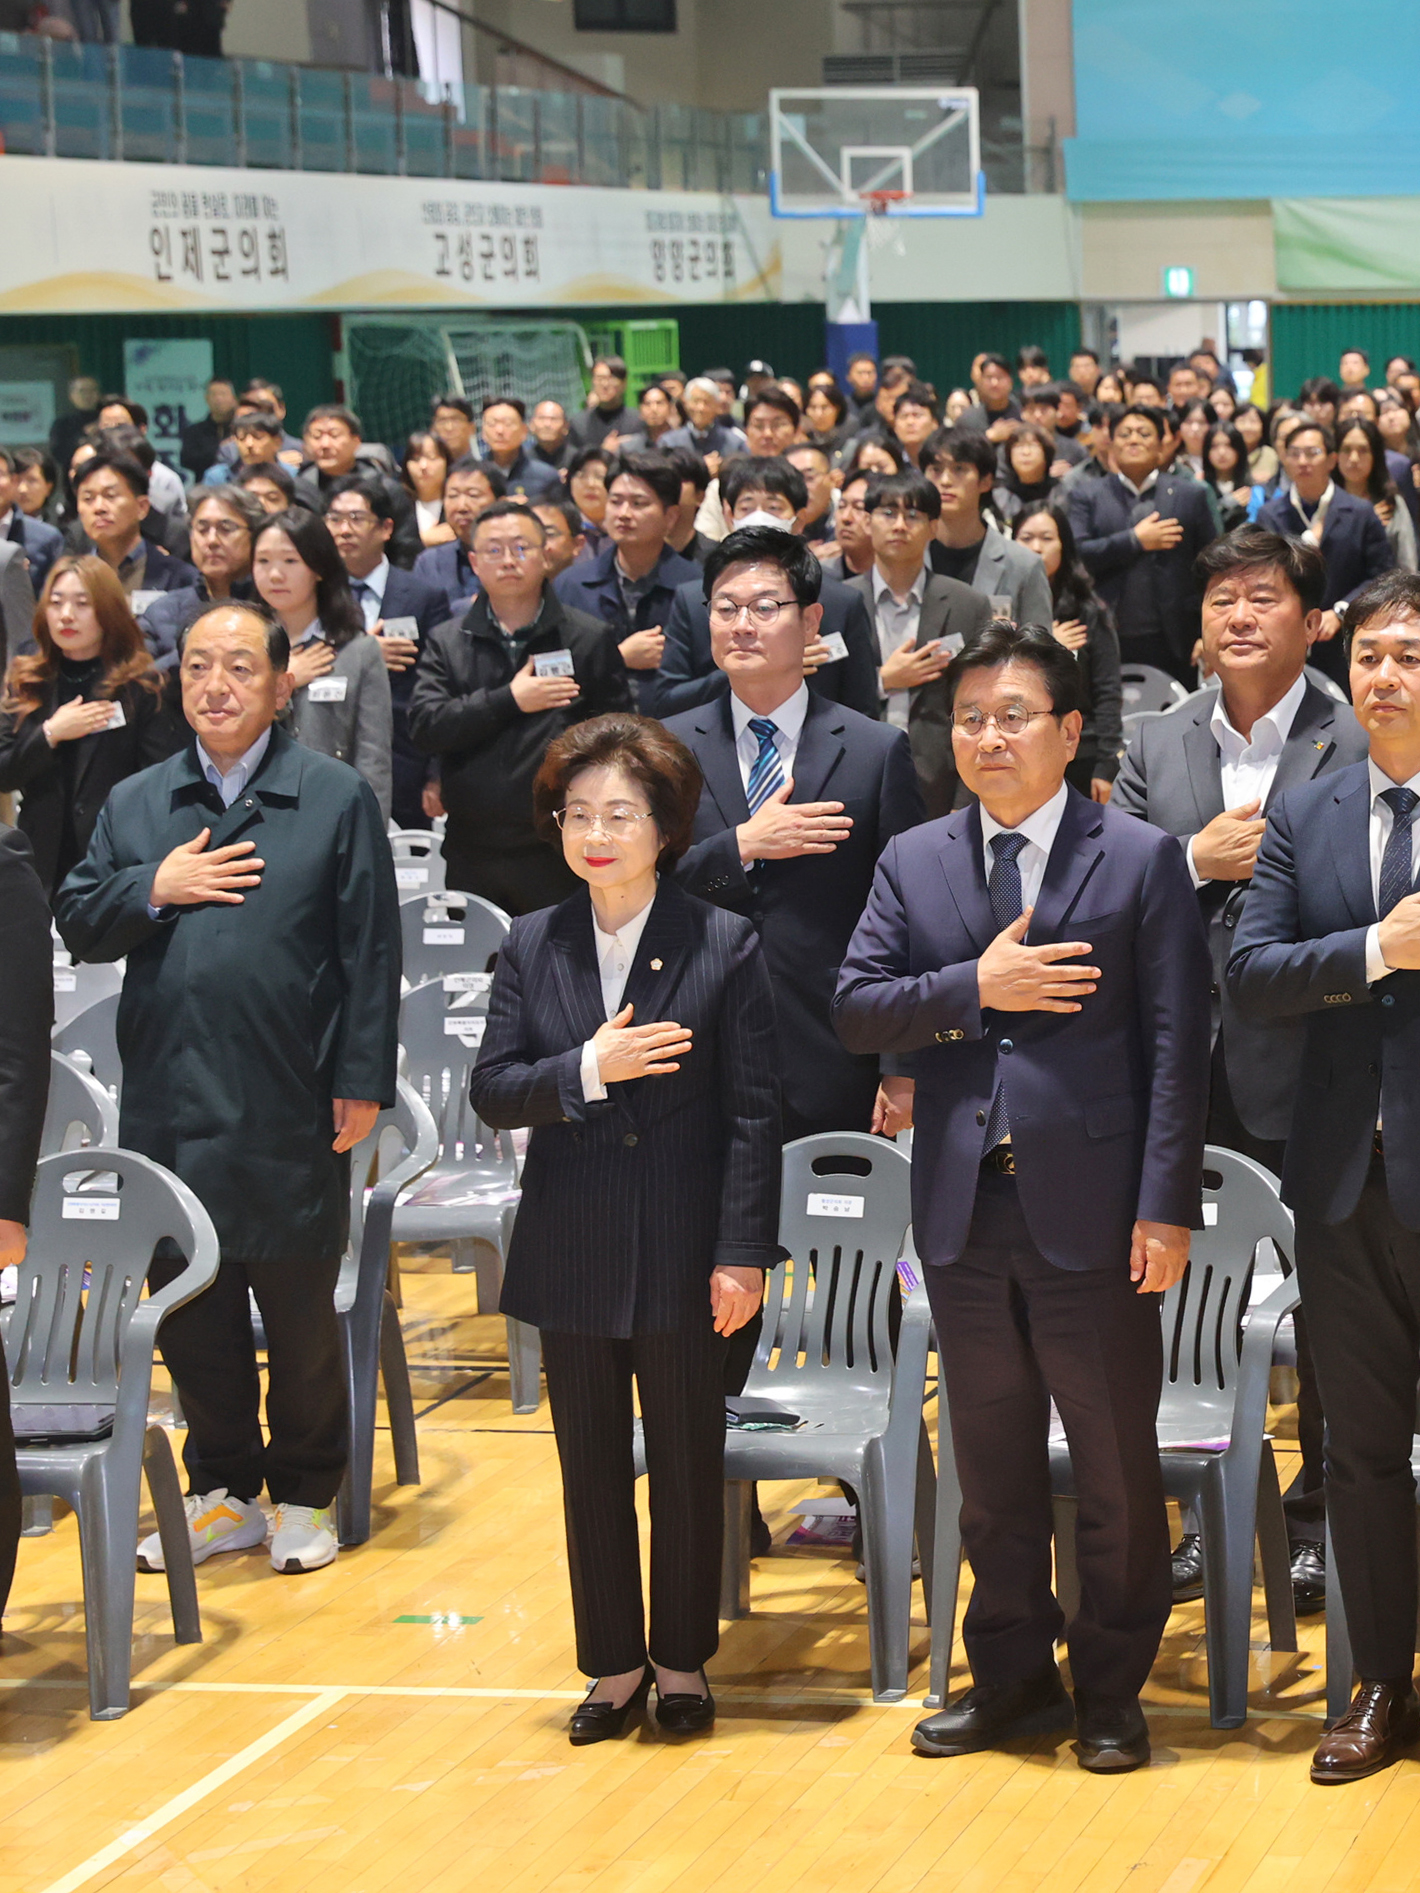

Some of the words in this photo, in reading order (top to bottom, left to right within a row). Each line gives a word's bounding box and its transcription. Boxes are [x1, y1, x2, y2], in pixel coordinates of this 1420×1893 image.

[150, 225, 289, 282] 인제군의회
[434, 232, 540, 282] 고성군의회
[650, 239, 736, 283] 양양군의회
